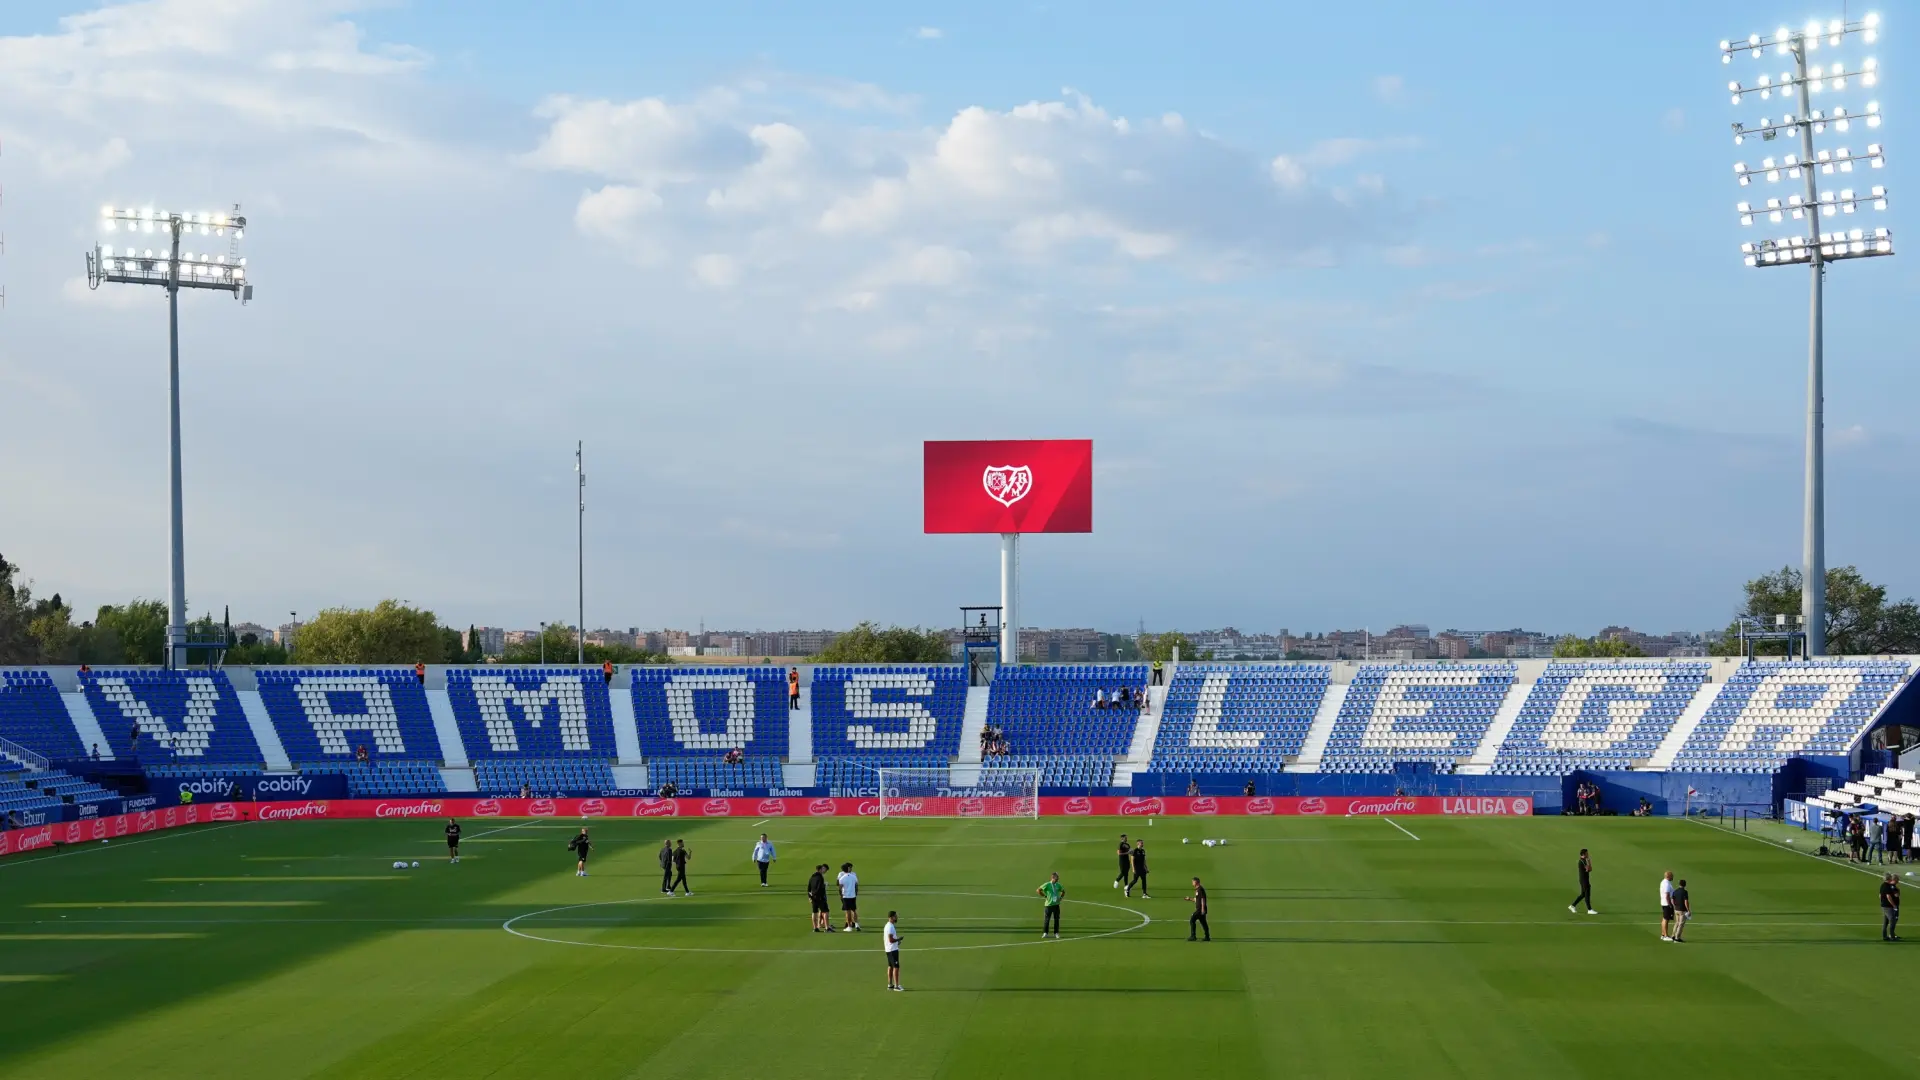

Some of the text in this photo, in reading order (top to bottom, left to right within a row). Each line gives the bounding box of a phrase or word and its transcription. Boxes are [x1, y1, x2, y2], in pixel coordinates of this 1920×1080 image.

[1187, 667, 1866, 752] LEGA
[179, 778, 234, 796] cabify
[257, 776, 312, 794] cabify
[710, 788, 744, 797] Mahou
[769, 788, 803, 797] Mahou
[1442, 798, 1507, 814] LALIGA
[23, 811, 46, 826] Ebury
